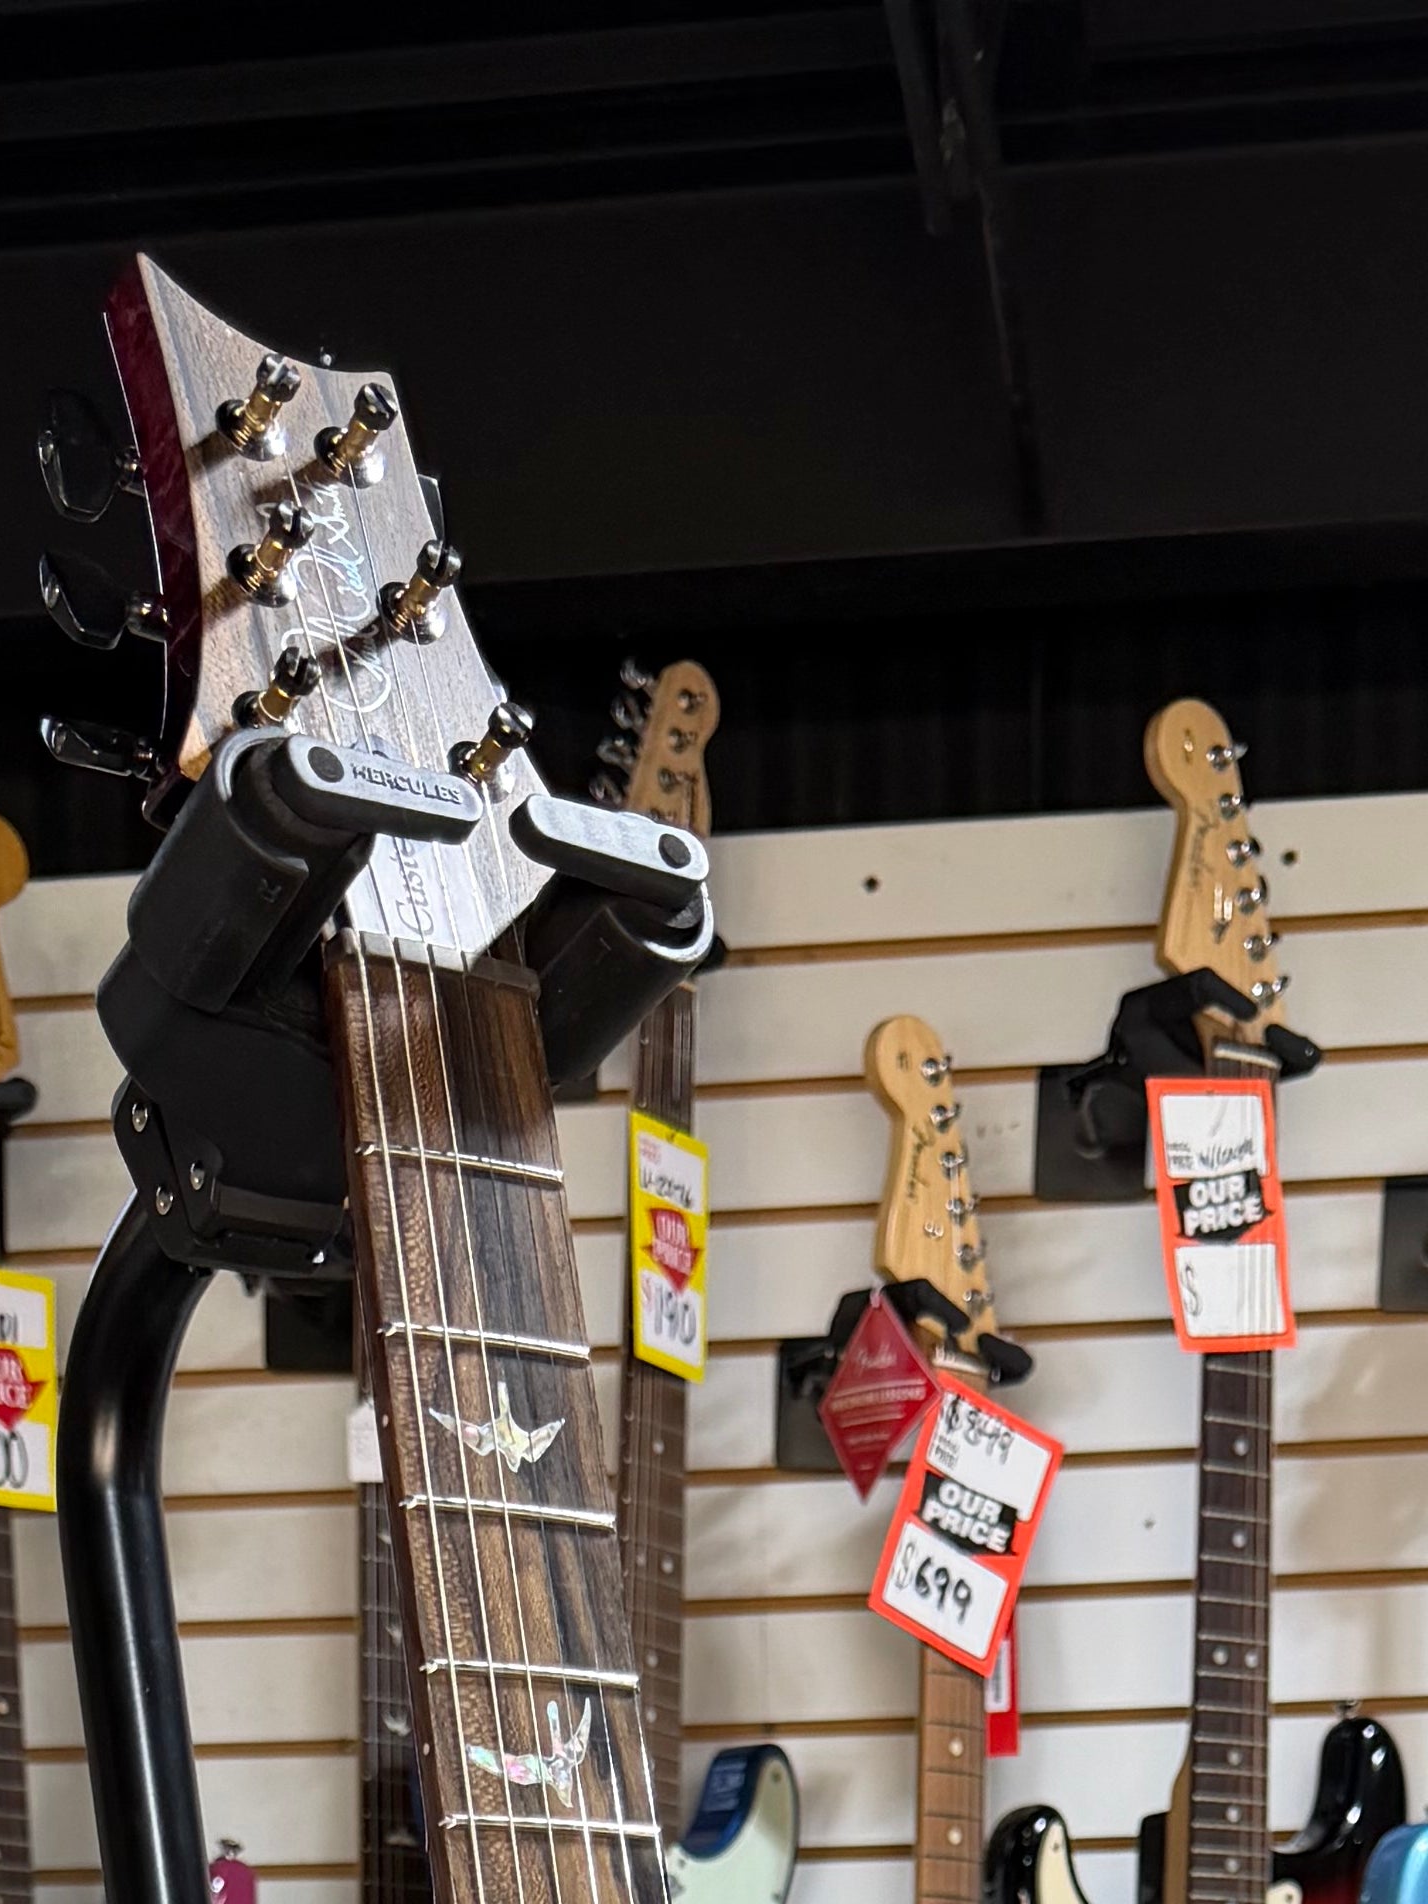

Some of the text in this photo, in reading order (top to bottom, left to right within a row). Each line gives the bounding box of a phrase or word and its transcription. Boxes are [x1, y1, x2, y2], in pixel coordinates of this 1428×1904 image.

[350, 763, 464, 805] HERCULES
[1189, 1175, 1245, 1208] OUR
[1183, 1196, 1264, 1237] PRICE
[938, 1481, 1003, 1525] OUR
[922, 1499, 1010, 1552] PRICE
[893, 1543, 974, 1626] $699
